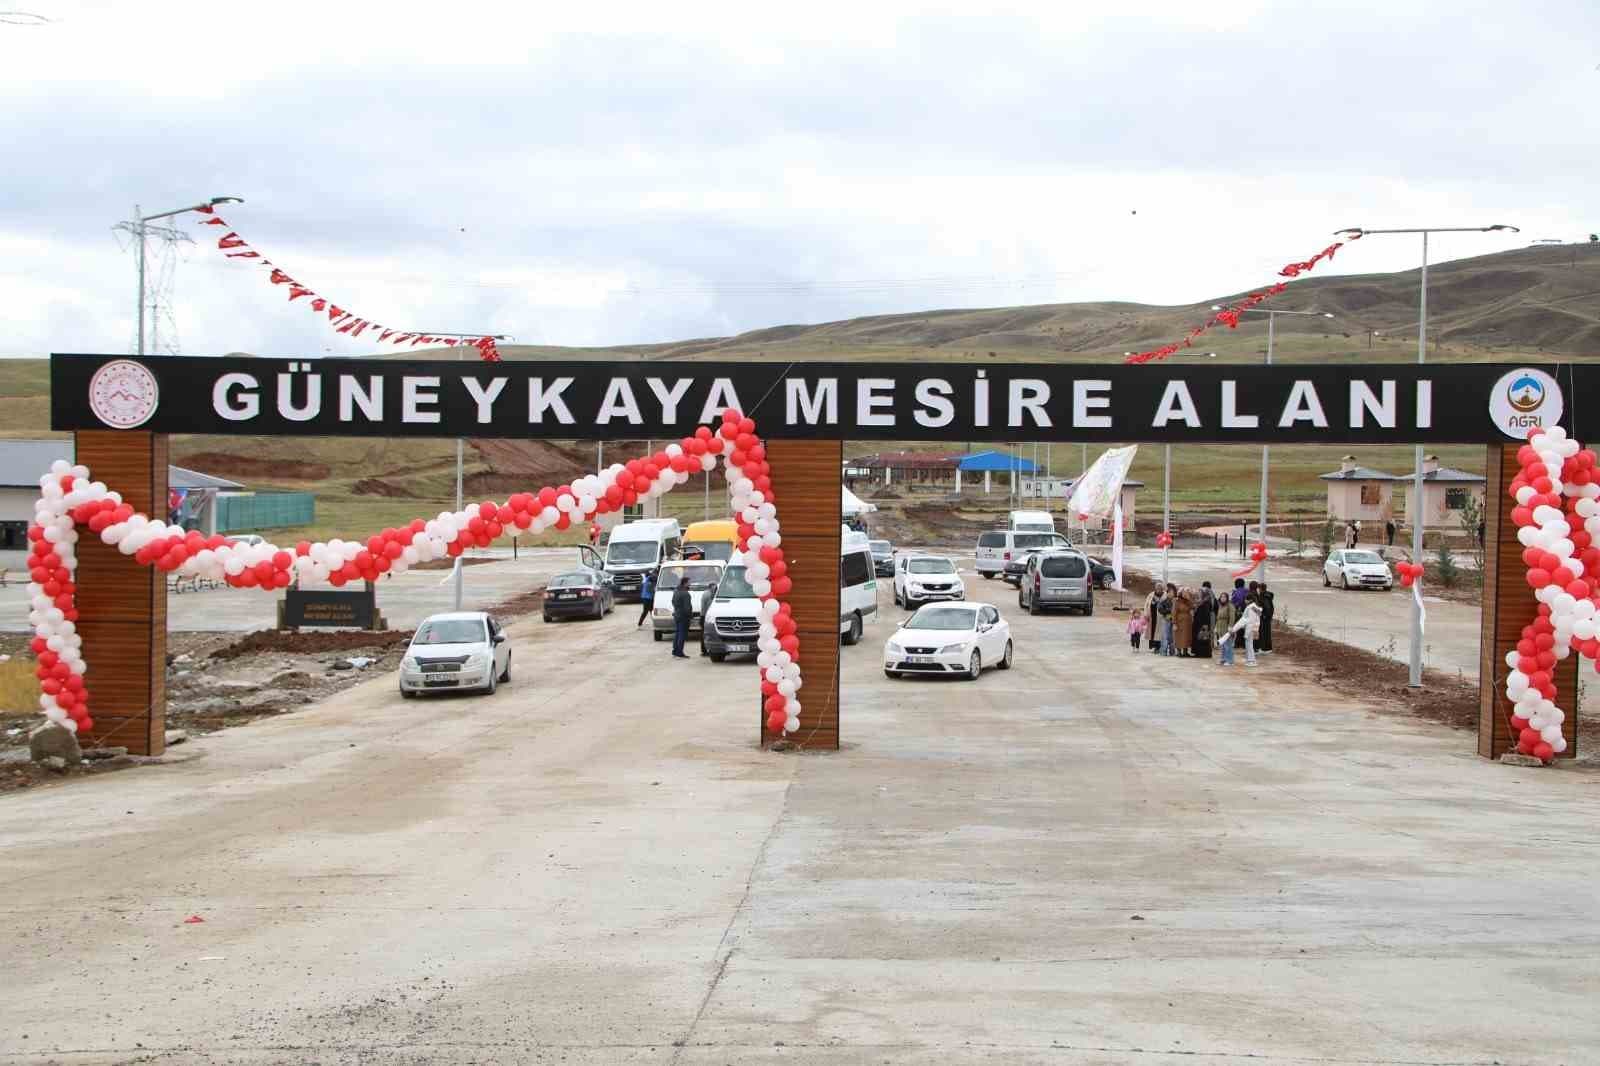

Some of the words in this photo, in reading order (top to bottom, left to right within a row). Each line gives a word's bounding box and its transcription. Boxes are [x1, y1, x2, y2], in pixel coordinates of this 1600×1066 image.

[213, 361, 748, 427] GÜNEYKAYA
[785, 368, 1113, 429] MESİRE
[1152, 379, 1433, 429] ALANI
